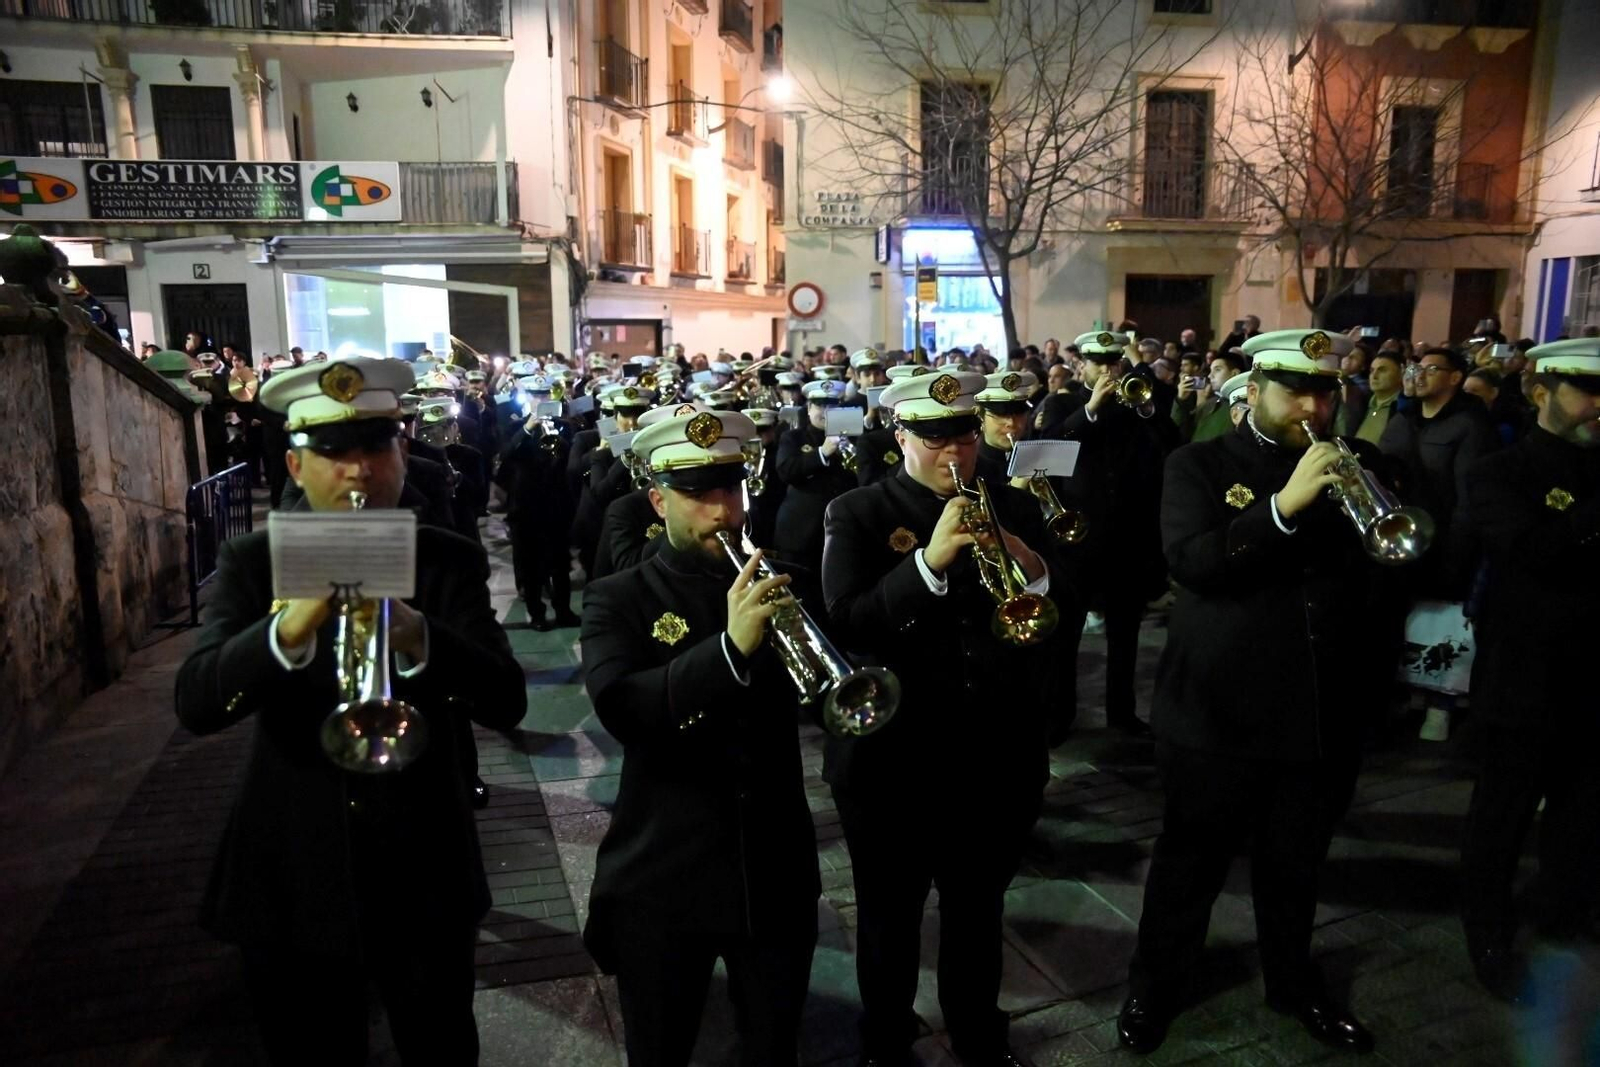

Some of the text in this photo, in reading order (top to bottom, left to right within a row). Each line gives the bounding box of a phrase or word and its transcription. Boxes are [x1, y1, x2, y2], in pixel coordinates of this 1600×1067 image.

[89, 162, 296, 184] GESTIMARS
[818, 192, 859, 202] PLAZA
[147, 200, 197, 208] INTEGRAL
[201, 200, 214, 208] EN
[219, 200, 298, 208] TRANSACCIONES
[820, 204, 857, 213] DE LA
[101, 209, 181, 218] INMOBILIARIAS
[197, 265, 207, 278] 2
